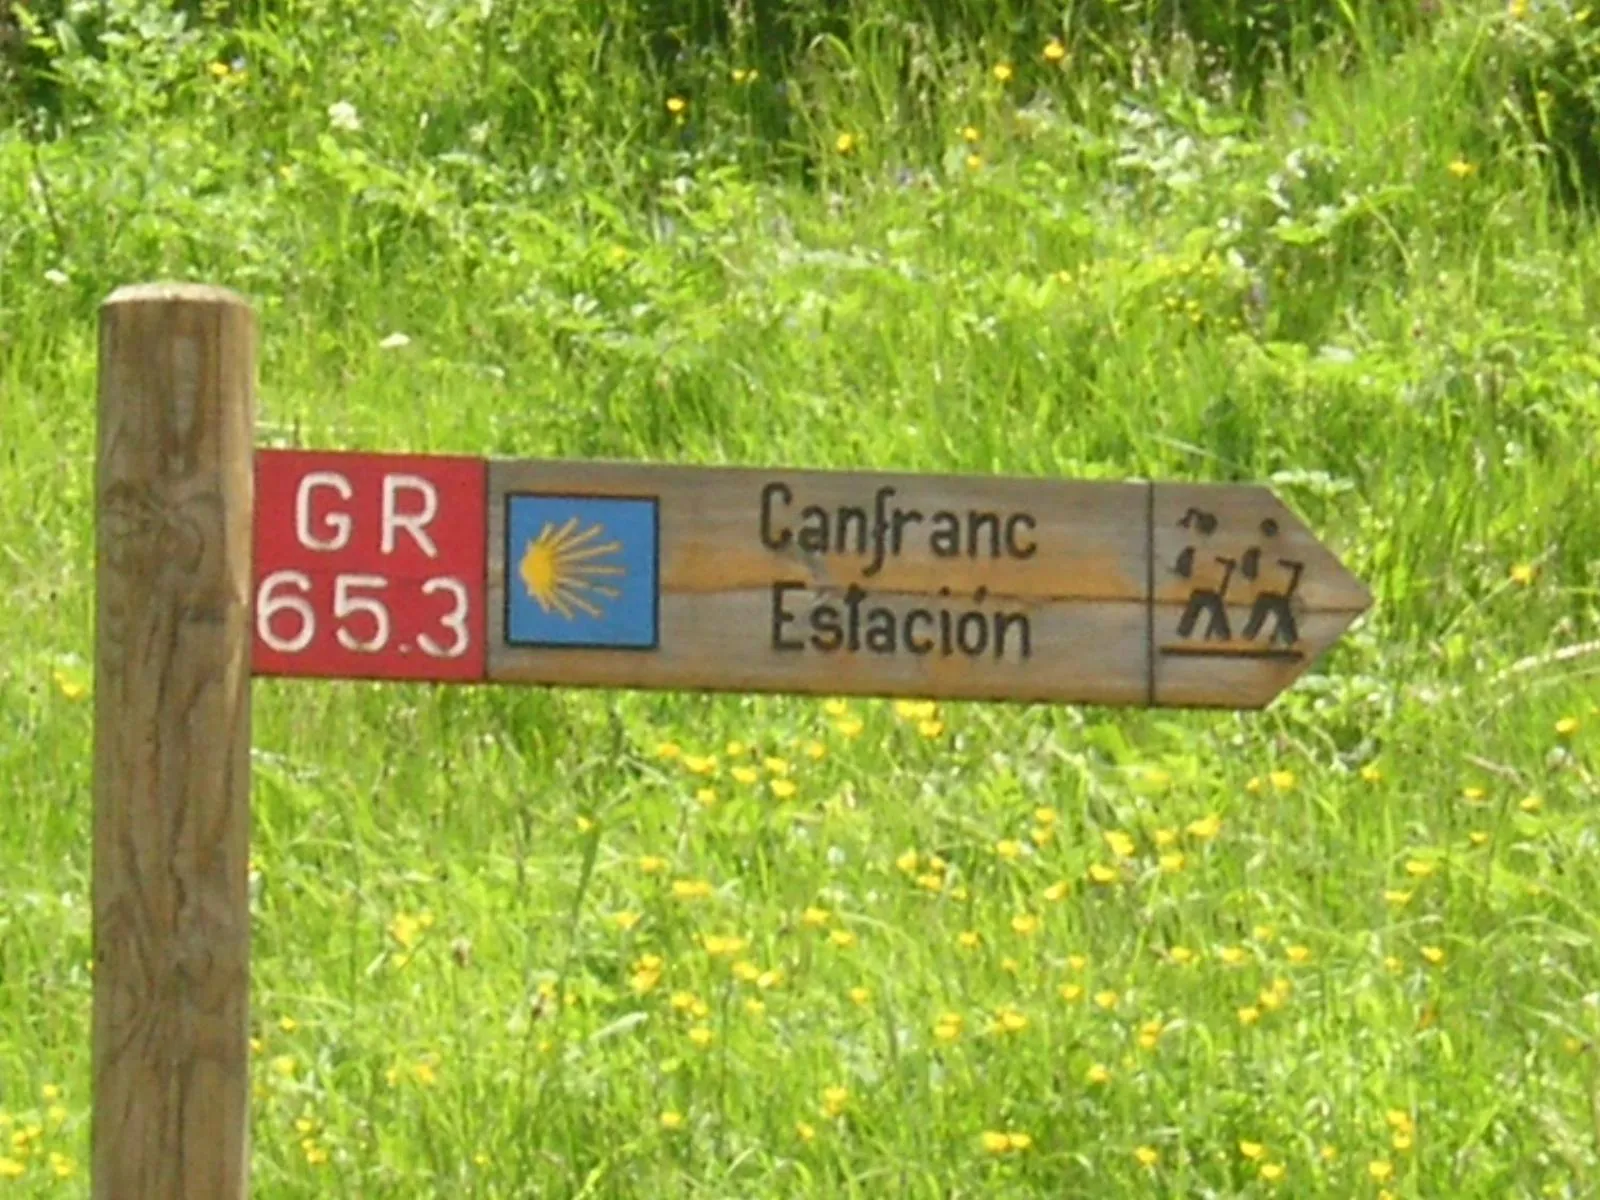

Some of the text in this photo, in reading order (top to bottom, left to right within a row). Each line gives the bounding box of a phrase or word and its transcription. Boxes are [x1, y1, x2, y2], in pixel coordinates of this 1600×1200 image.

[760, 481, 1038, 577] Canfranc
[256, 570, 470, 658] 65.3
[771, 580, 1033, 660] Estación
